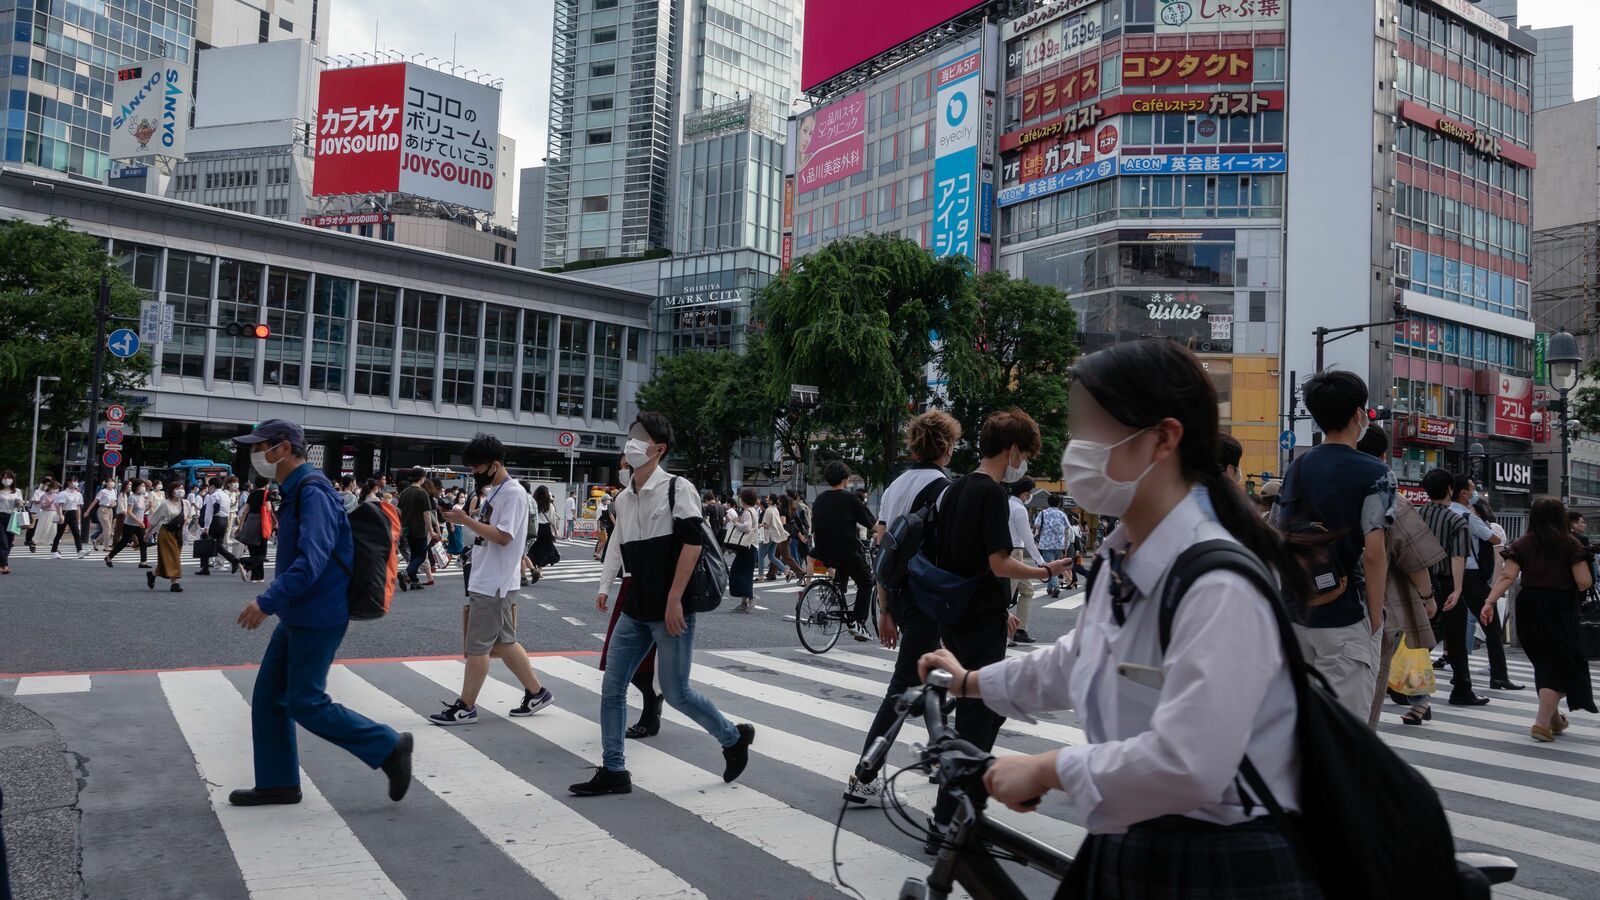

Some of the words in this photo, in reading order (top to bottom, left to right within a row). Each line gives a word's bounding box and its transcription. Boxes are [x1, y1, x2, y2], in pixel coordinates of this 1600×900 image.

[942, 57, 976, 82] 当ビル5F
[1008, 51, 1022, 67] 9F
[1124, 53, 1249, 77] コンタクト
[113, 71, 161, 129] SANKYO
[1024, 69, 1098, 114] プライス
[1209, 92, 1268, 114] ガスト
[162, 69, 184, 147] SANKYO
[408, 86, 477, 123] ココロの
[321, 104, 399, 136] カラオケ
[406, 111, 494, 152] ボリューム、
[1065, 105, 1103, 134] ガスト
[319, 132, 399, 156] JOYSOUND
[940, 126, 973, 146] eyecity
[1475, 130, 1502, 157] ガスト
[405, 133, 495, 169] あげていこう。
[1044, 139, 1091, 175] ガスト
[1125, 159, 1163, 170] AEON
[1171, 156, 1283, 171] 英会話イーオン
[402, 152, 495, 190] JOYSOUND
[807, 150, 859, 184] 品川美容外科
[1004, 162, 1020, 180] 7F
[1028, 168, 1094, 196] 英会話イーオン
[1099, 163, 1110, 175] 6F
[347, 214, 379, 224] JOYSOUND
[665, 294, 703, 306] MARK
[709, 290, 742, 301] CITY
[684, 284, 720, 293] SHIBUYA
[1146, 303, 1203, 320] Ushi8
[1502, 400, 1525, 419] アコム
[1495, 461, 1531, 485] LUSH
